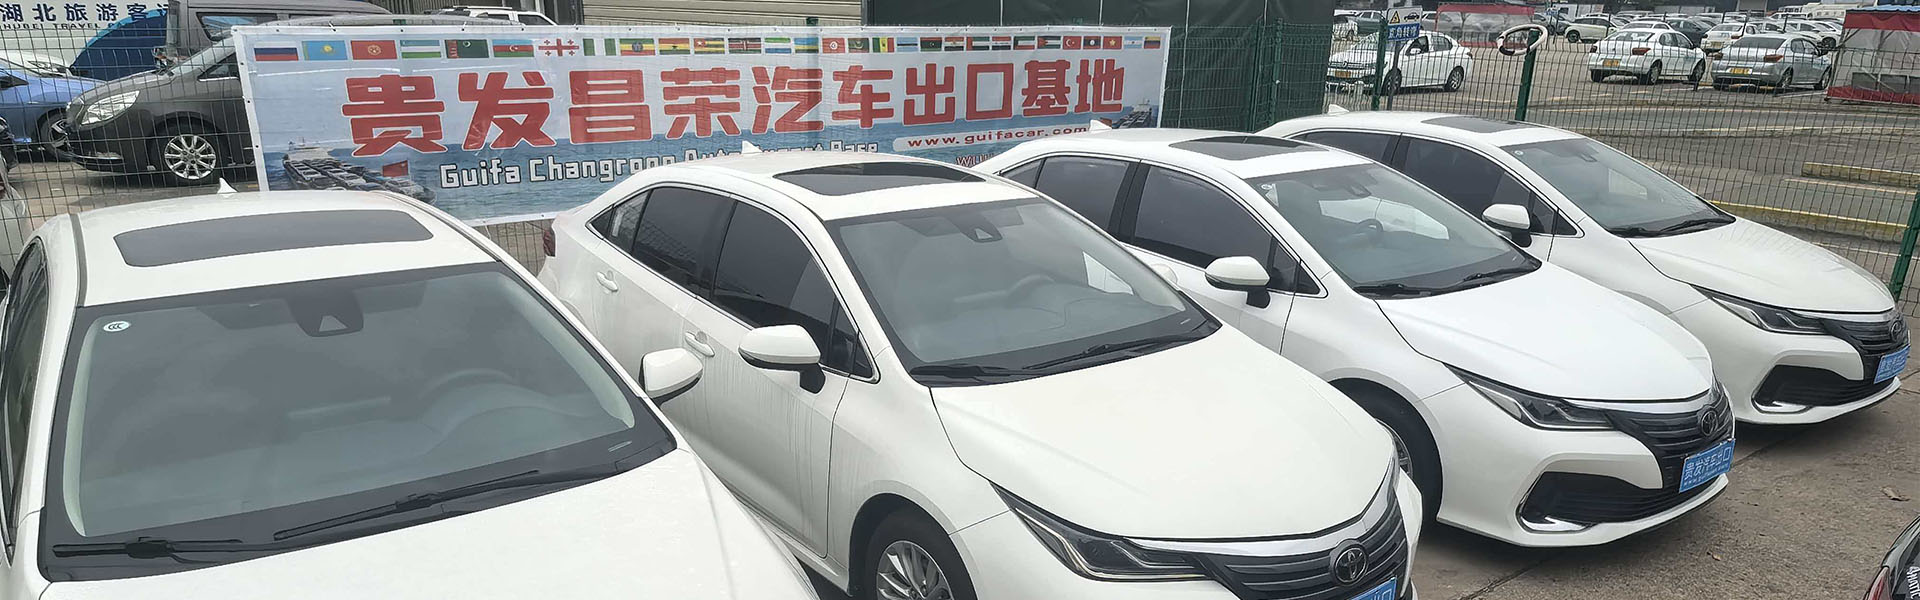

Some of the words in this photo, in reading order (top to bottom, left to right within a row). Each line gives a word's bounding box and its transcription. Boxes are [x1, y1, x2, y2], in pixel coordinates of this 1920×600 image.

[341, 58, 1125, 157] 贵发昌荣汽车出口基地
[439, 158, 522, 189] Guifa
